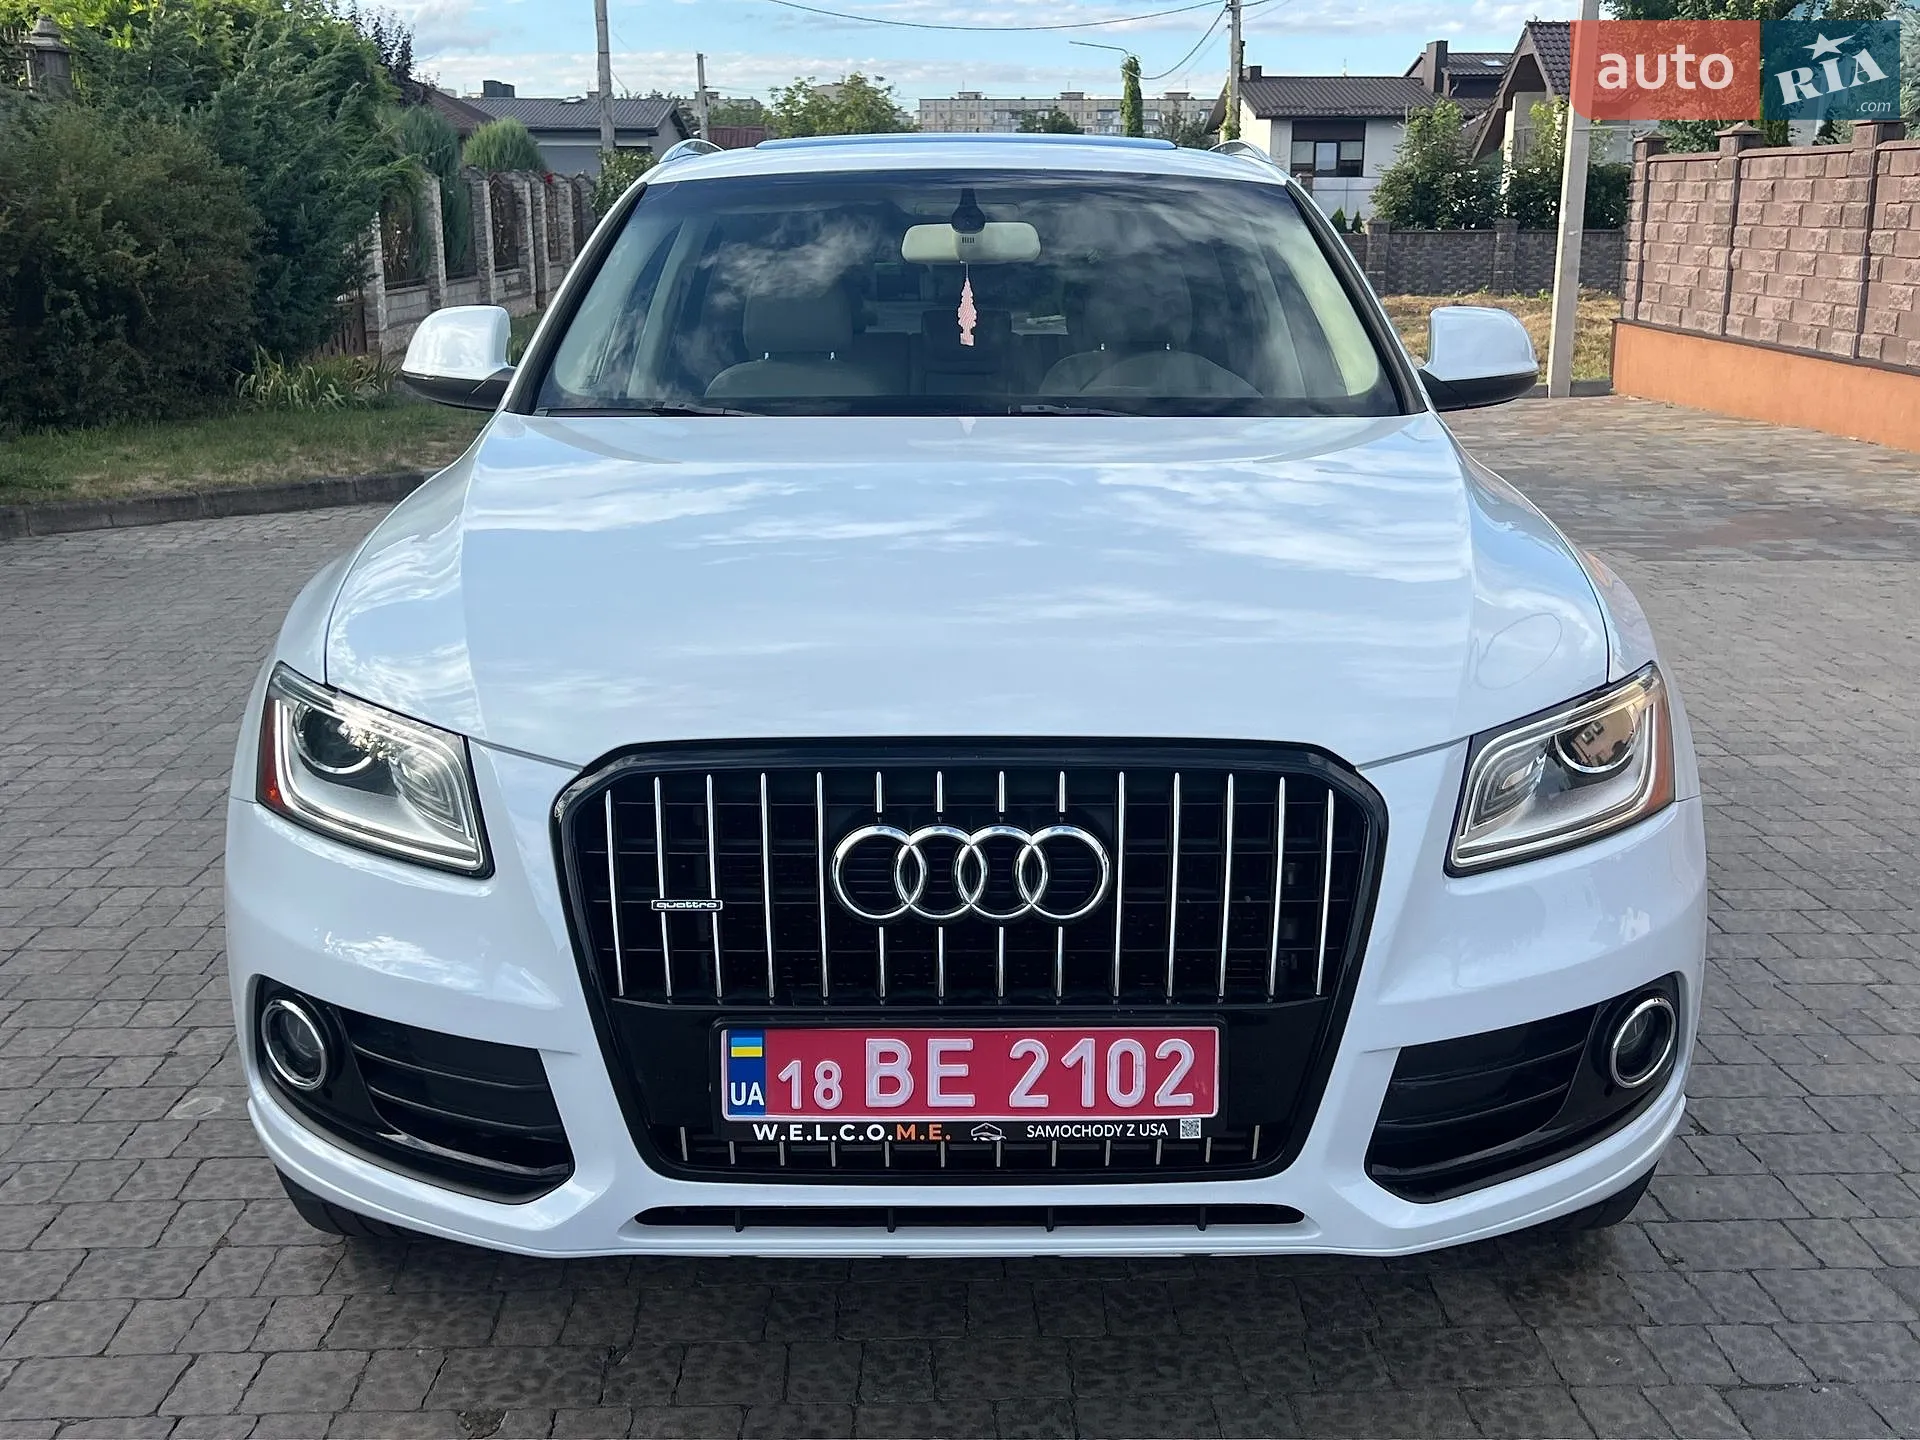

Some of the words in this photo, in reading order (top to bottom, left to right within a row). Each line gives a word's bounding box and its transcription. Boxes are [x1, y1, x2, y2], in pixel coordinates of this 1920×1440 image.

[656, 901, 718, 909] quattro
[777, 1059, 842, 1110] 18
[865, 1037, 976, 1108] BE
[1008, 1037, 1195, 1108] 2102
[731, 1081, 765, 1107] UA
[1026, 1124, 1124, 1139] SAMOCHODY
[1126, 1124, 1137, 1138] Z
[1139, 1124, 1169, 1138] USA
